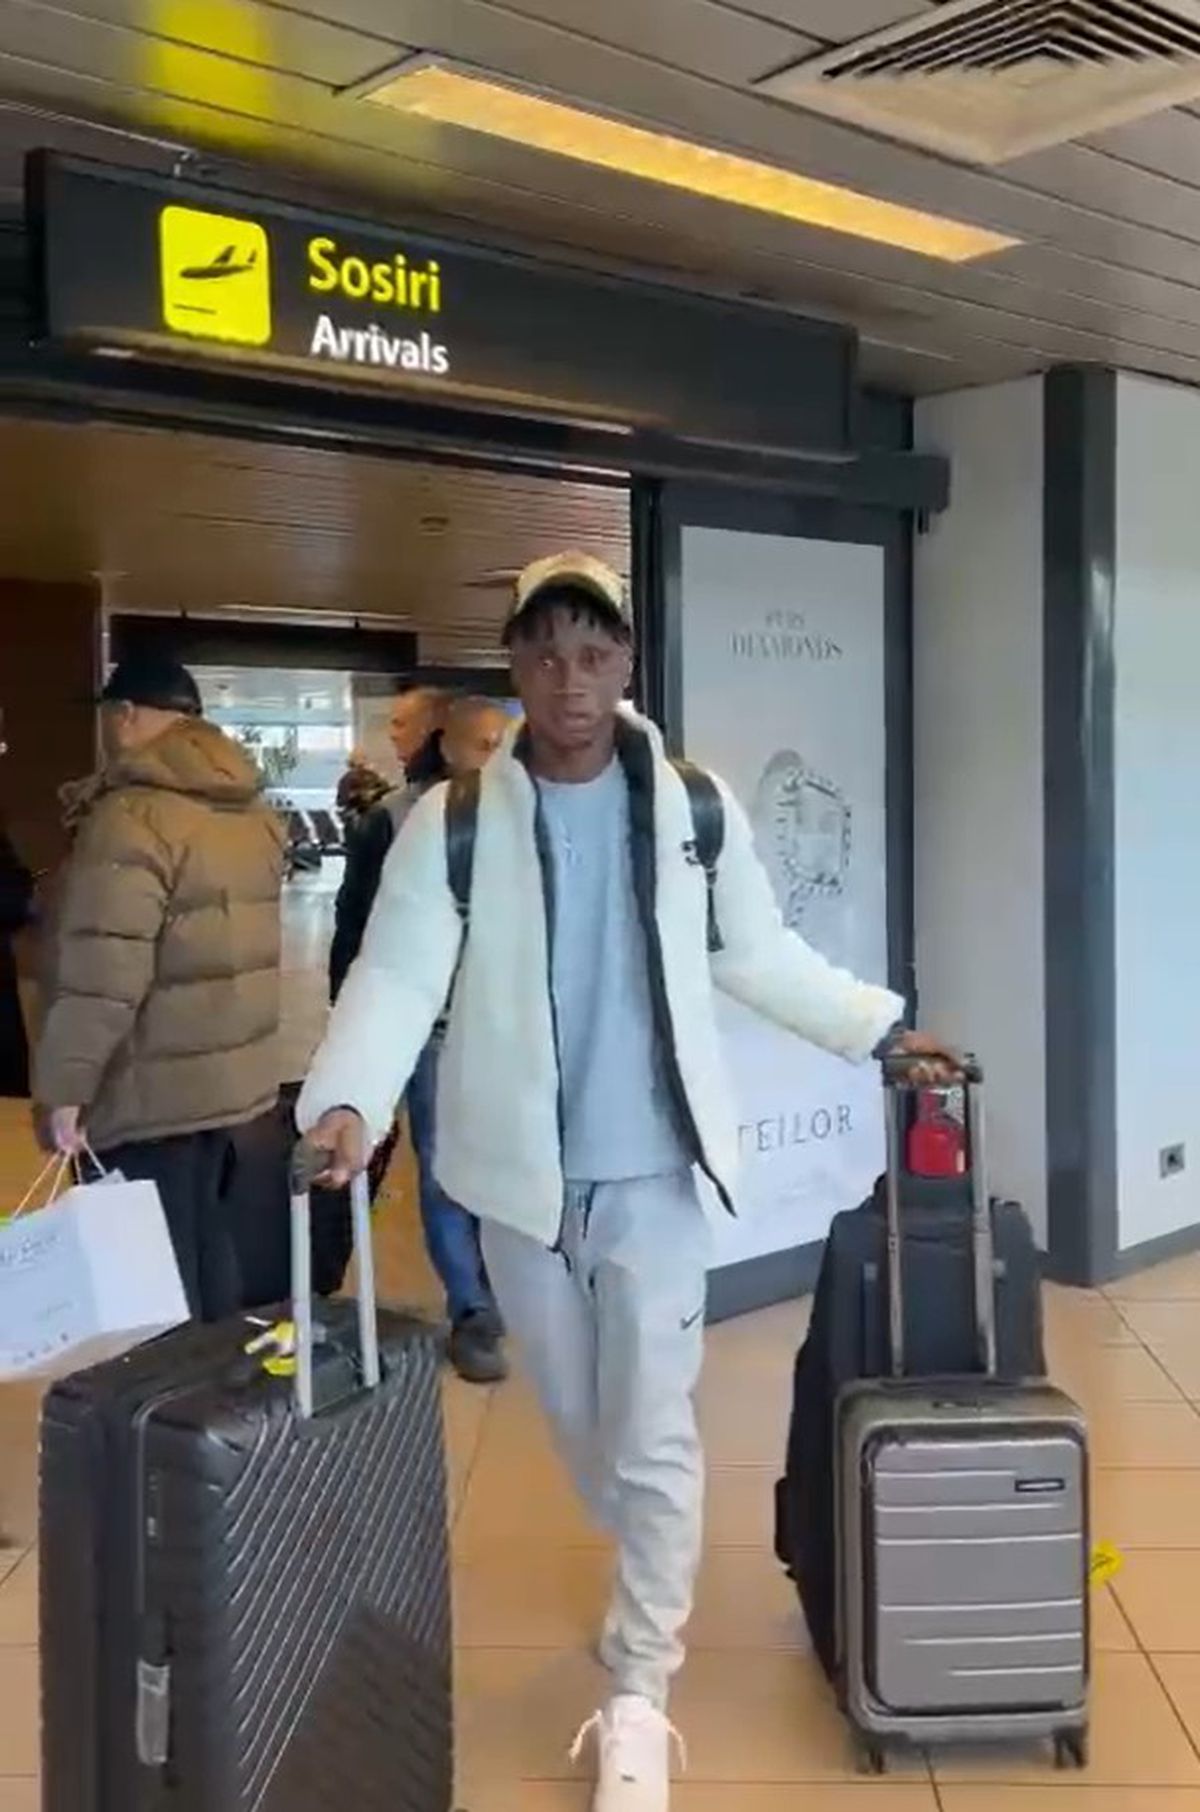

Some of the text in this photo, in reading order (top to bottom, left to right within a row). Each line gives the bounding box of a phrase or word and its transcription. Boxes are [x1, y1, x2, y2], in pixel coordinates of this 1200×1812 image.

[308, 236, 441, 312] Sosiri
[311, 314, 450, 374] Arrivals
[730, 632, 843, 660] DIAMONDS
